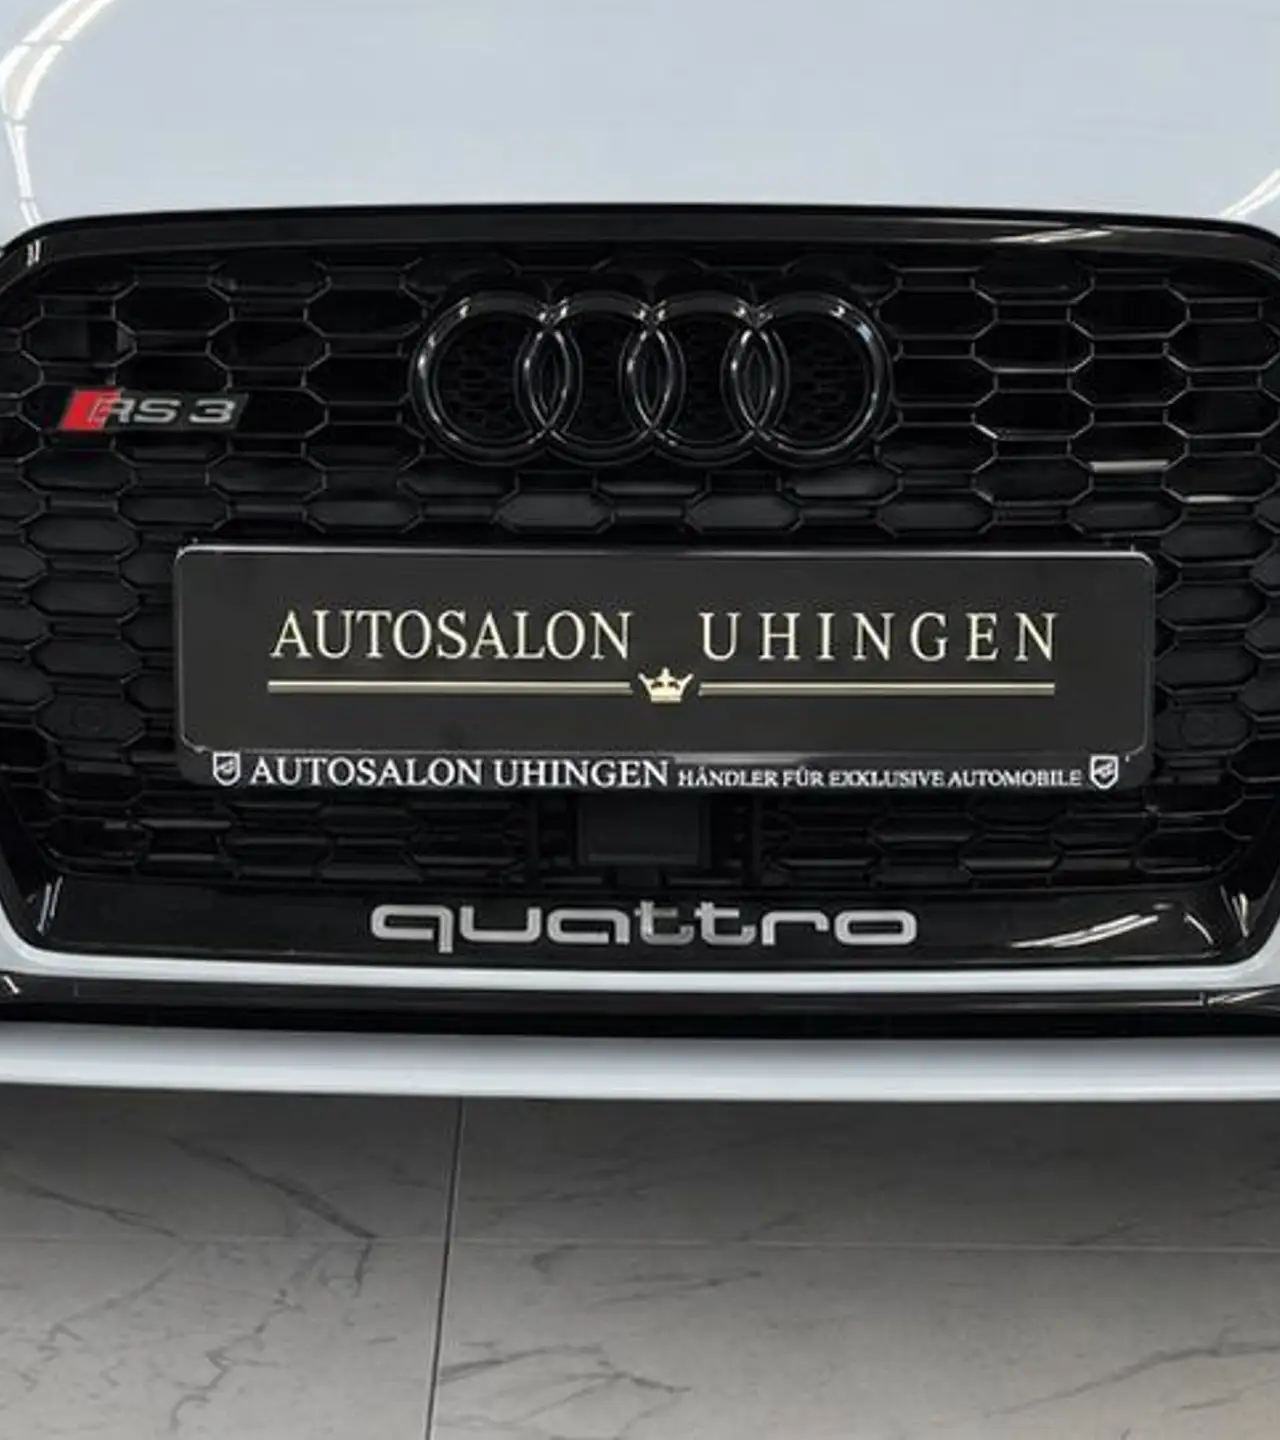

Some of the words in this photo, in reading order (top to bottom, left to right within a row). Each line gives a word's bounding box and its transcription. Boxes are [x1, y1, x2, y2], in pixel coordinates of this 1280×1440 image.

[86, 396, 181, 427] RS
[189, 398, 237, 424] 3
[270, 609, 633, 661] AUTOSALON
[700, 610, 1058, 662] UHINGEN
[249, 757, 482, 788] AUTOSALON
[494, 759, 669, 787] UHINGEN
[677, 765, 779, 788] HÄNDLER
[782, 764, 824, 788] FÜR
[947, 768, 1083, 788] AUTOMOBILE
[371, 901, 918, 953] quattro
